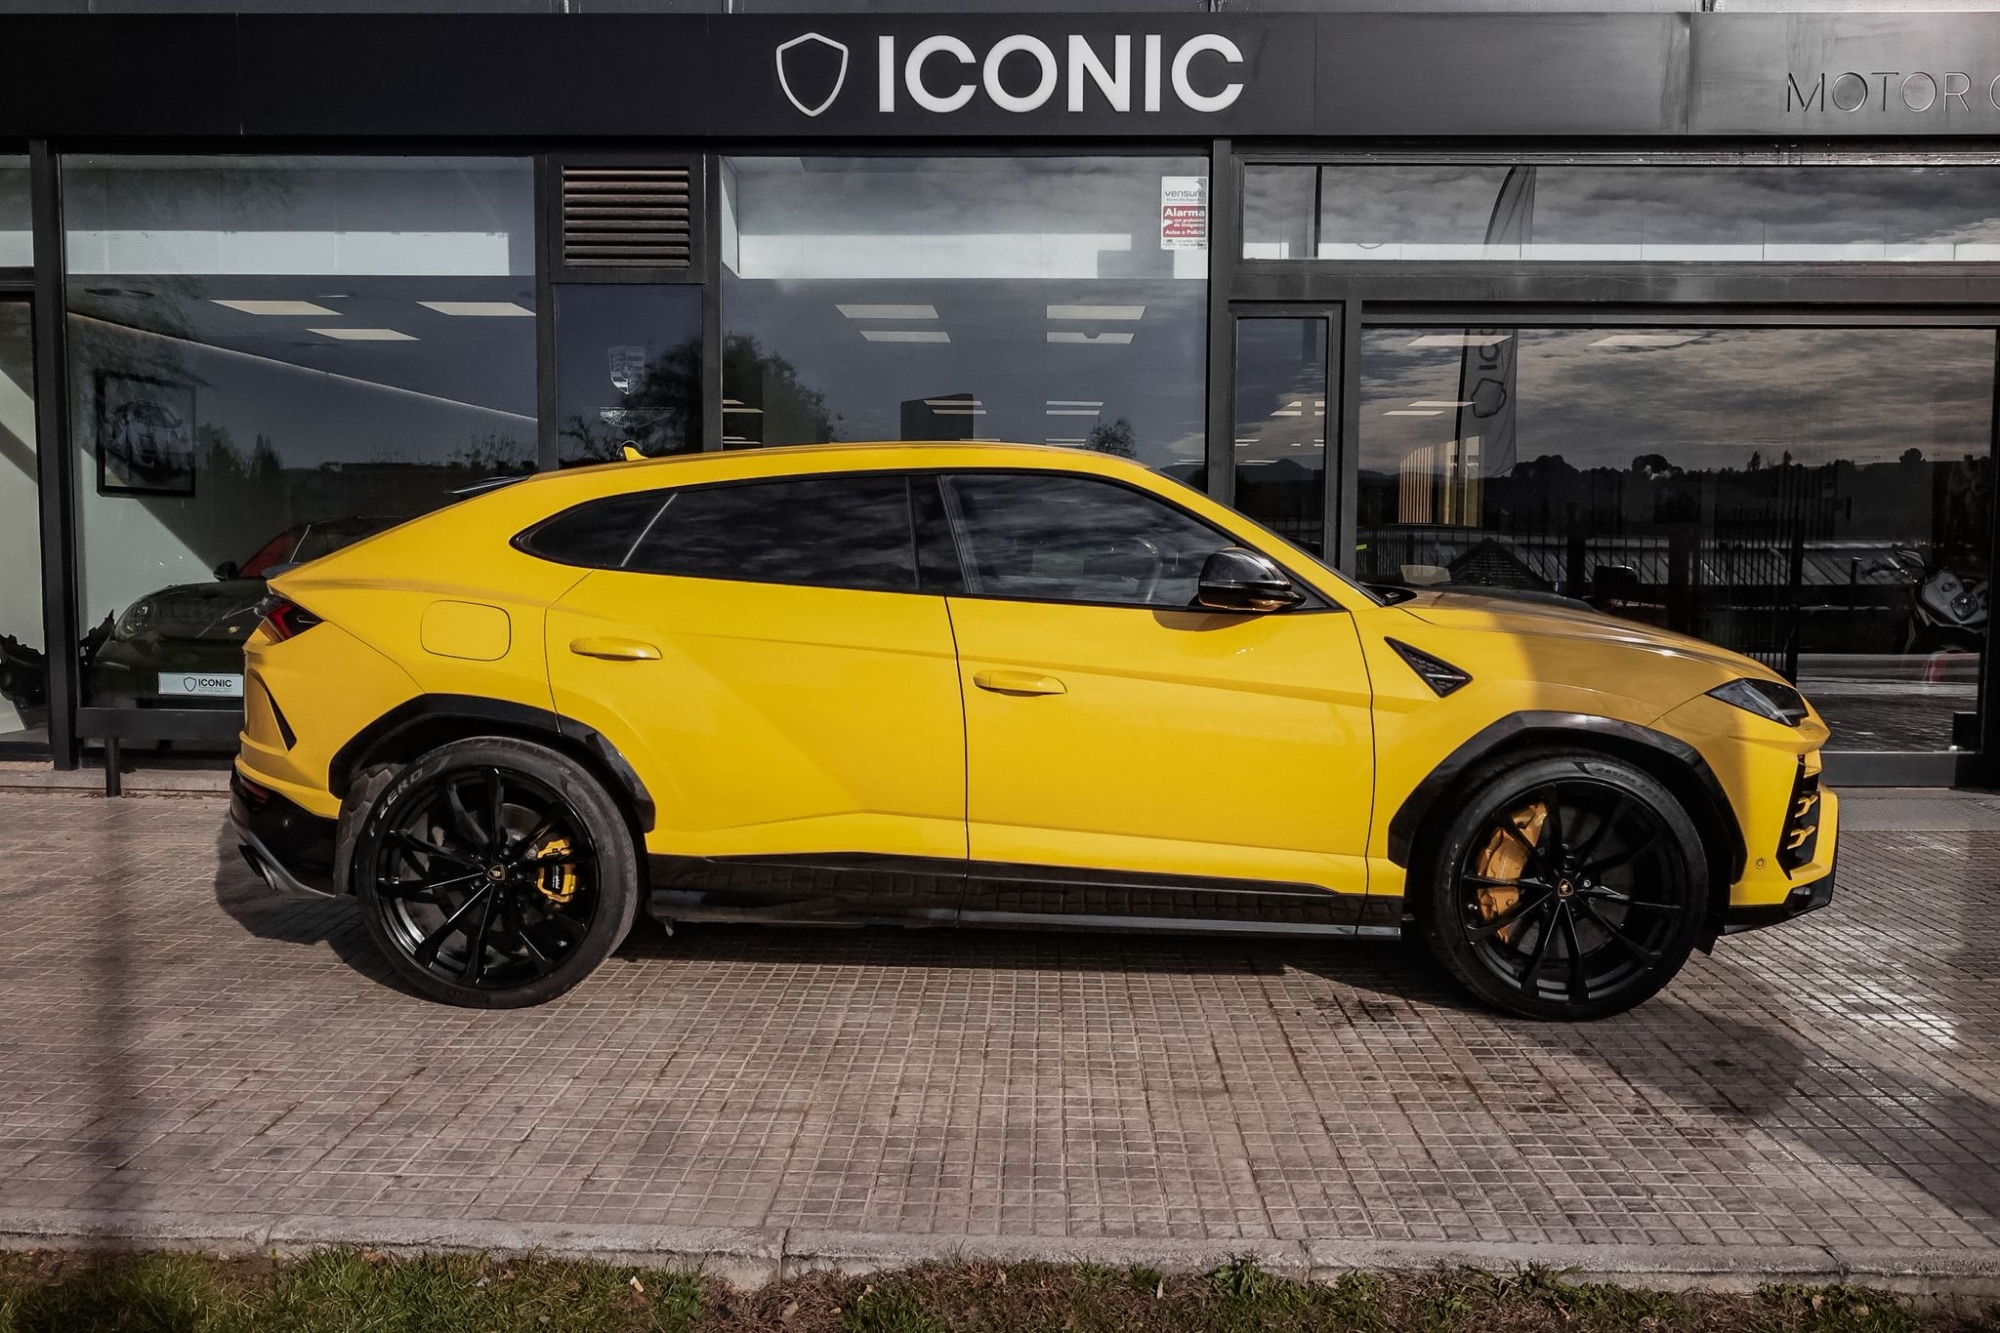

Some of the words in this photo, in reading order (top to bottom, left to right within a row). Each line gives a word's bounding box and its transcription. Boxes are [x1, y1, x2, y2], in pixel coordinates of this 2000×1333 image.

[878, 34, 1244, 113] ICONIC
[1787, 72, 1971, 112] MOTOR
[1164, 208, 1205, 217] Alarma
[198, 679, 232, 687] ICONIC
